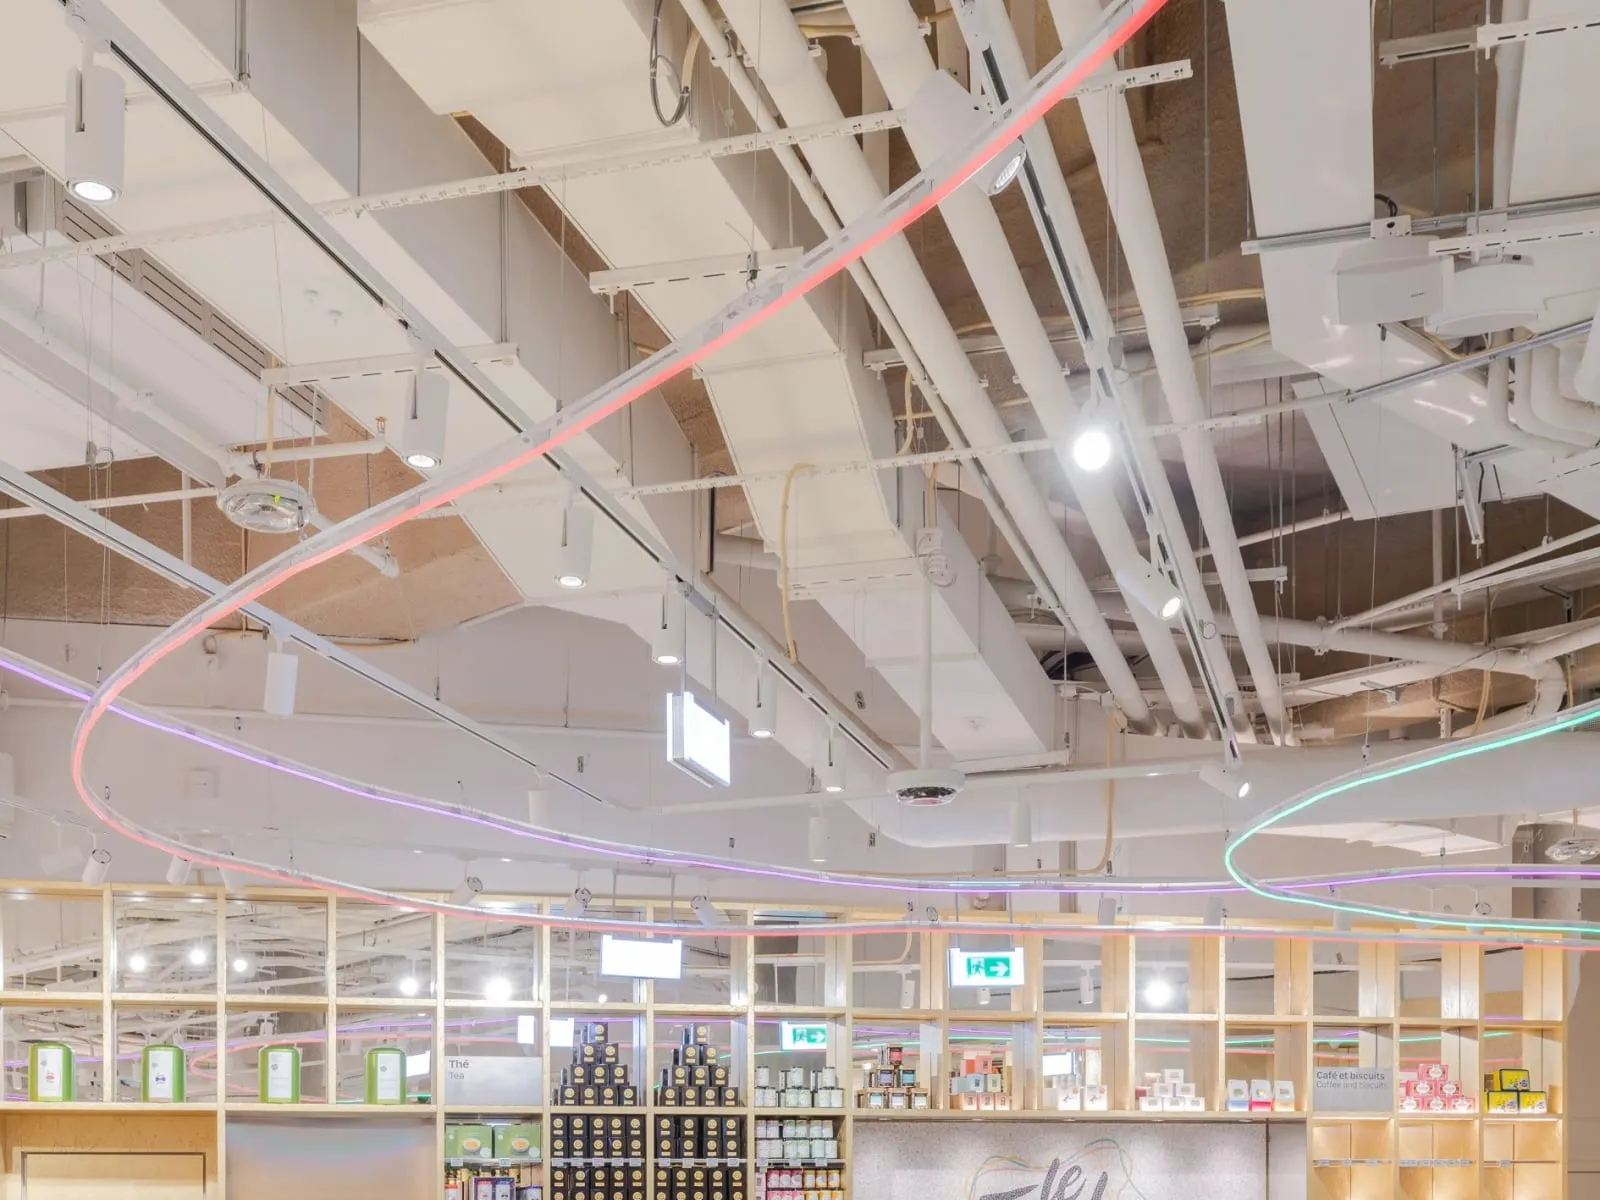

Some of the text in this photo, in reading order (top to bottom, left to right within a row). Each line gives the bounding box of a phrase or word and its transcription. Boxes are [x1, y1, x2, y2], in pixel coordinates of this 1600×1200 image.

[448, 1059, 469, 1068] Thé
[448, 1071, 465, 1079] Tea
[1316, 1071, 1385, 1080] Café et biscuits
